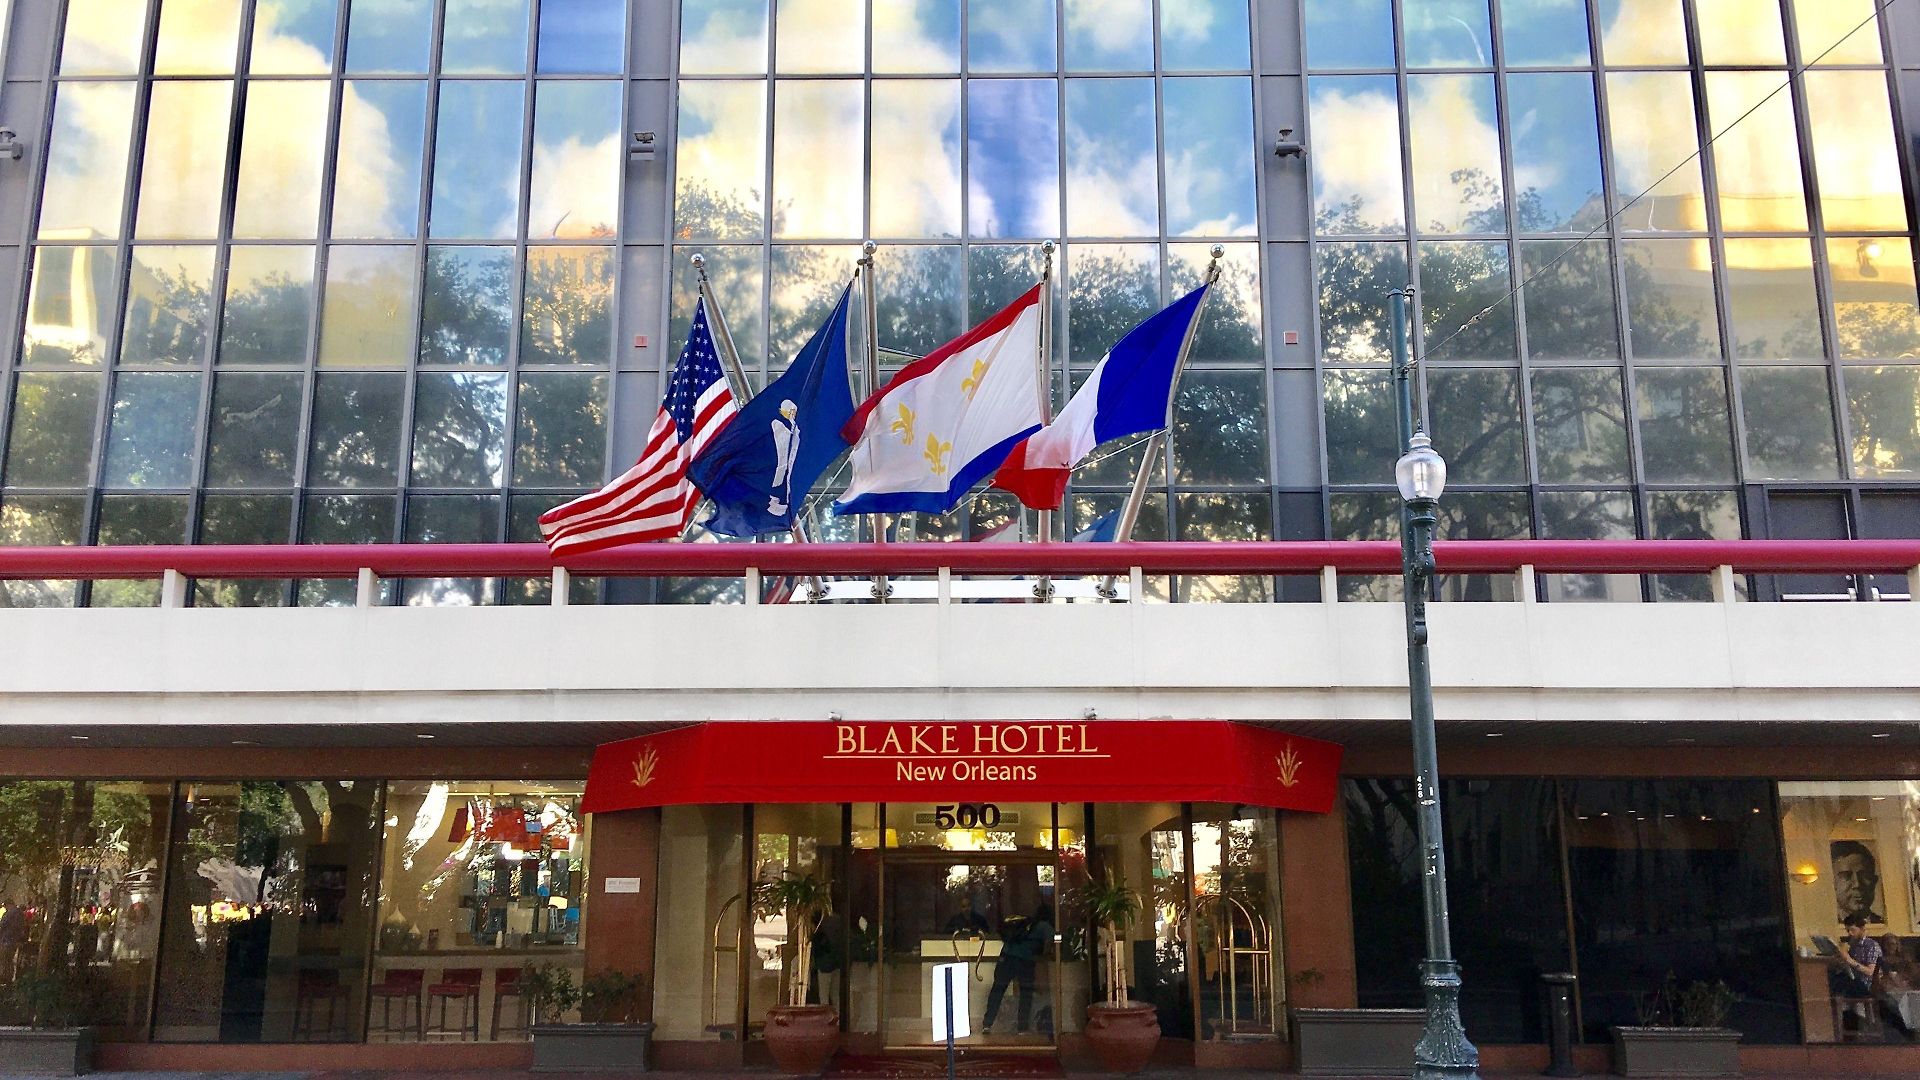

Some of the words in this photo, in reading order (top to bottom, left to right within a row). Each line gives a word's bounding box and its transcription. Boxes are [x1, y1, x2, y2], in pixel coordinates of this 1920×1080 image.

[836, 725, 960, 754] BLAKE
[972, 724, 1099, 753] HOTEL
[896, 761, 946, 781] New
[952, 760, 1037, 781] Orleans
[935, 803, 1001, 830] 500
